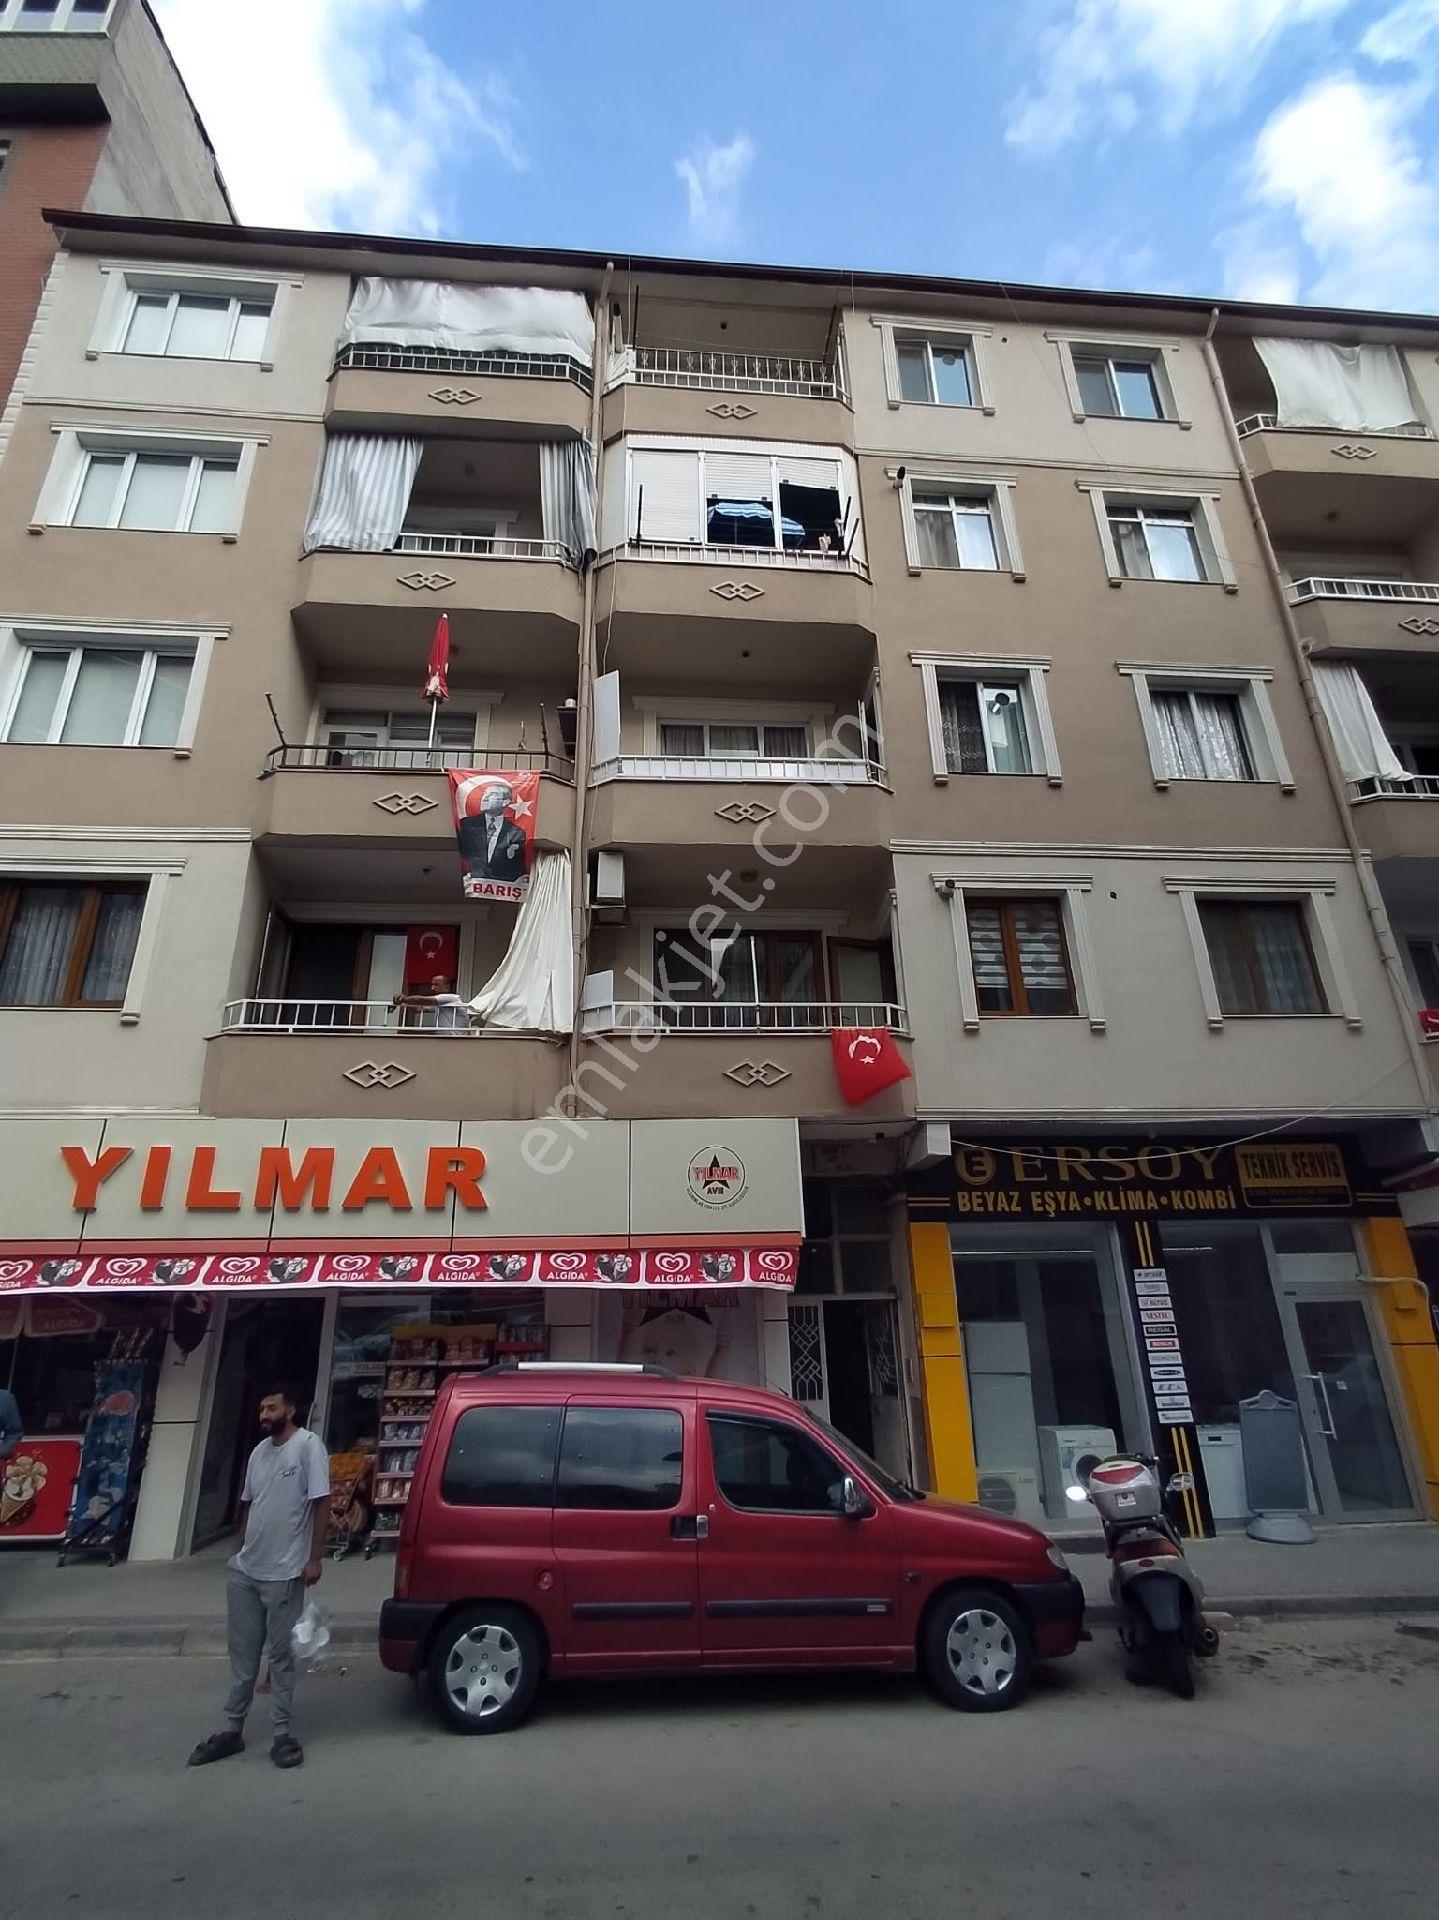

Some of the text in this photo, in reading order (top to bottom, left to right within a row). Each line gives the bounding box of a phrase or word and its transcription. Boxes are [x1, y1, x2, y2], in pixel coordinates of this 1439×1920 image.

[1009, 1146, 1222, 1181] ERSOY
[60, 1147, 488, 1209] YILMAR
[957, 1191, 1021, 1212] BEYAZ
[212, 1275, 252, 1283] ALGIDA
[326, 1272, 365, 1281] ALGIDA
[437, 1272, 477, 1281] ALGIDA
[546, 1272, 586, 1281] ALGIDA
[654, 1274, 692, 1283] ALGIDA
[759, 1272, 792, 1283] ALGIDA
